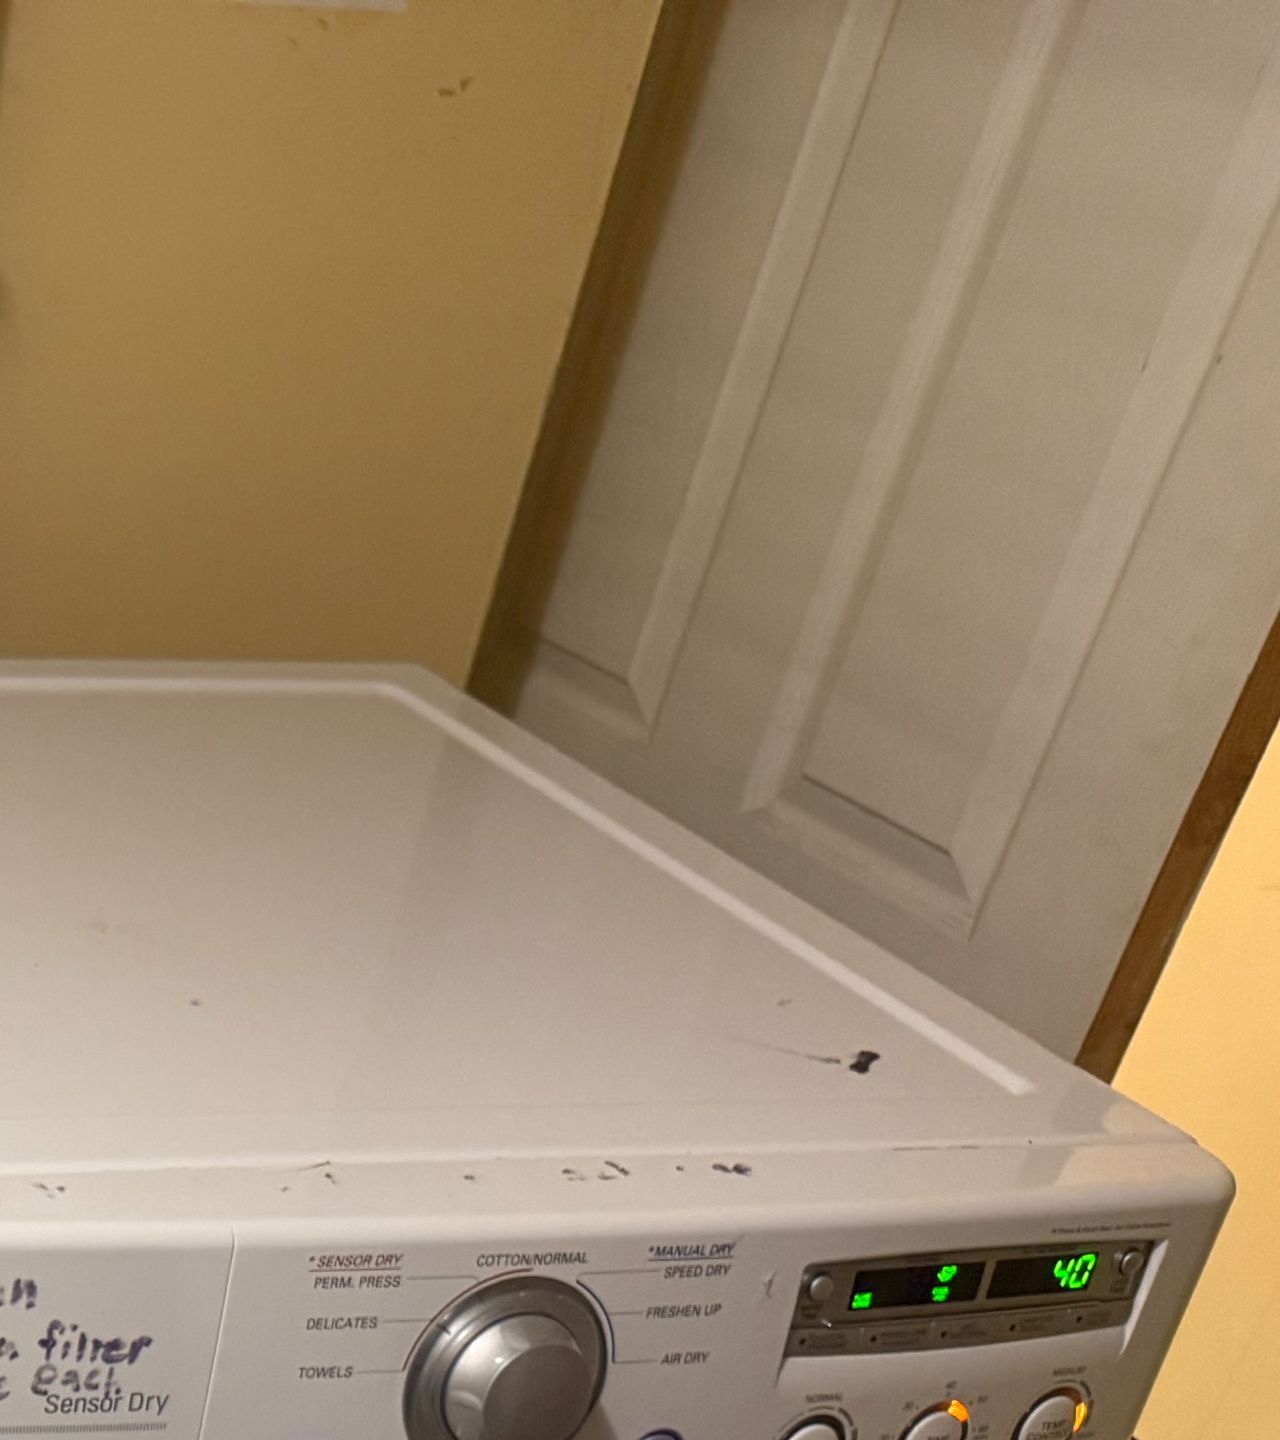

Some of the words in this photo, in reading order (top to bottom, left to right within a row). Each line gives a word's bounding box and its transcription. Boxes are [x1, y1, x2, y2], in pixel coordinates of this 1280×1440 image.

[710, 1242, 736, 1257] DRY
[374, 1253, 405, 1267] DRY
[476, 1252, 588, 1267] COTTON/NORMAL
[663, 1266, 703, 1279] SPEED
[705, 1264, 732, 1278] DRY
[1053, 1253, 1097, 1290] 40
[313, 1276, 354, 1289] PERM.
[358, 1275, 401, 1288] PRESS
[645, 1304, 701, 1319] FRESHEN
[703, 1303, 722, 1317] UP
[306, 1317, 378, 1331] DELICATES
[660, 1353, 683, 1365] AIR
[684, 1351, 710, 1365] DRY
[298, 1366, 353, 1379] TOWELS
[43, 1391, 123, 1415] Sensor
[128, 1391, 170, 1416] Dry
